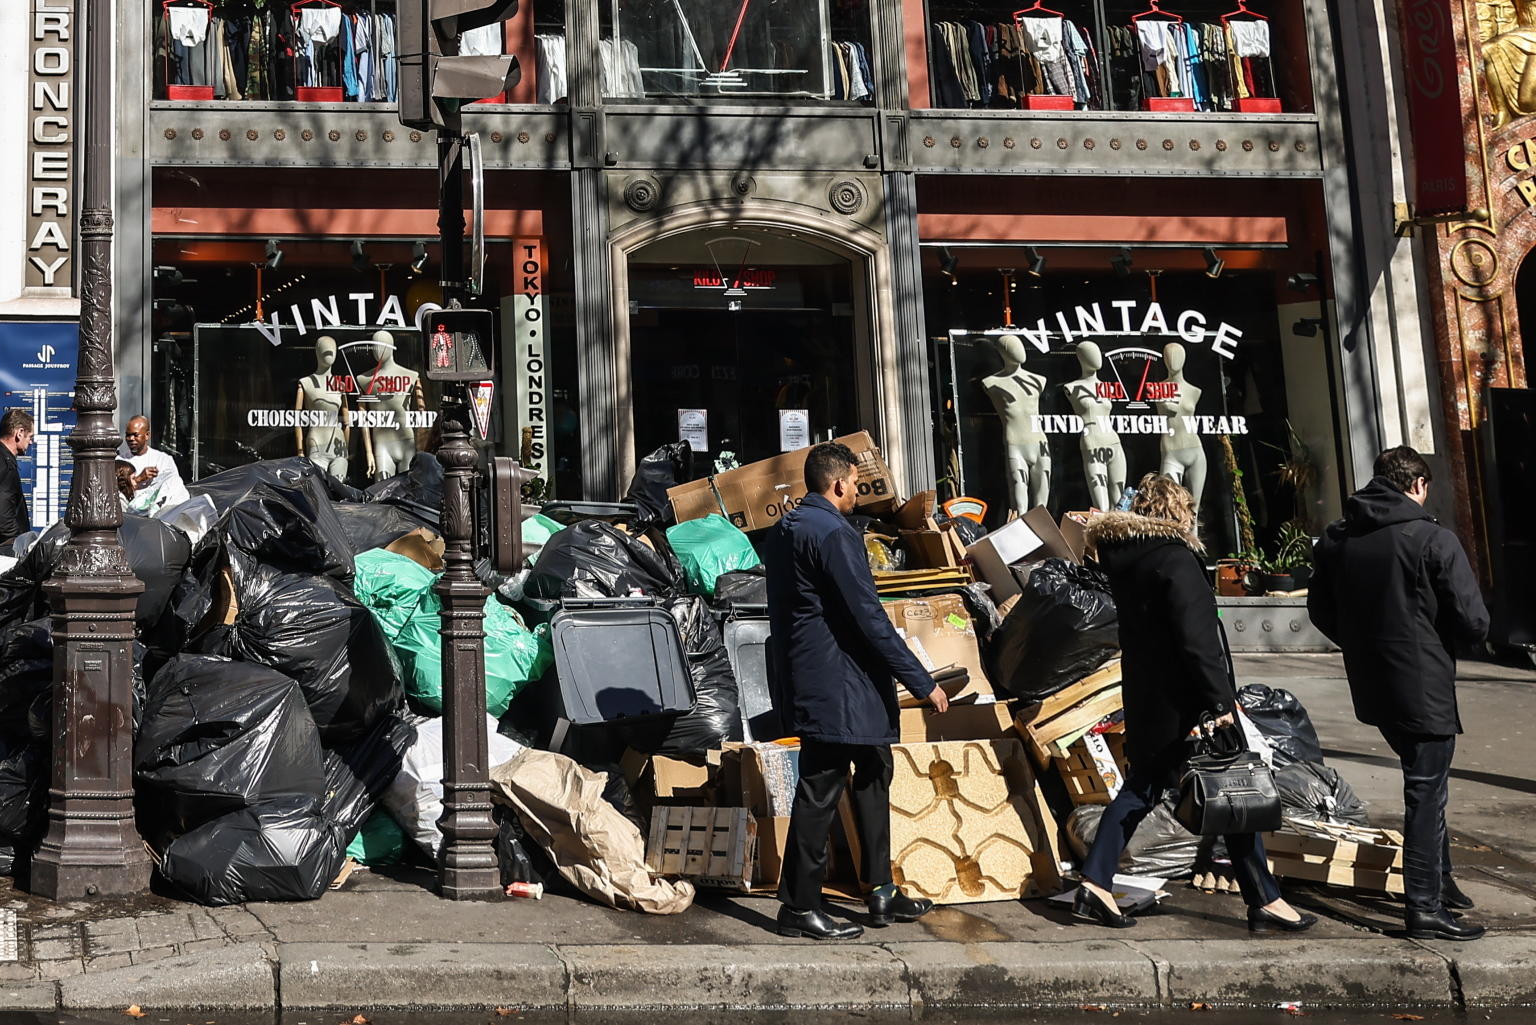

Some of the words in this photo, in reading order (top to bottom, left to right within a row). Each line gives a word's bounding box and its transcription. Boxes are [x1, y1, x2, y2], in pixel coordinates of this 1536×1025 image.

[28, 12, 71, 286] RONCERAY
[522, 245, 541, 322] TOKYO
[694, 269, 721, 286] KILO
[743, 270, 776, 287] SHOP
[1021, 300, 1243, 359] VINTAGE
[326, 375, 354, 393] KILO
[377, 375, 410, 393] SHOP
[1095, 381, 1124, 399] KILO
[1146, 381, 1179, 399] SHOP
[526, 343, 545, 459] LONDRES
[247, 409, 343, 429] CHOISISSEZ,
[348, 410, 400, 430] PESEZ,
[1030, 414, 1090, 438] FIND,
[1096, 415, 1175, 437] WEIGH,
[1181, 416, 1249, 435] WEAR
